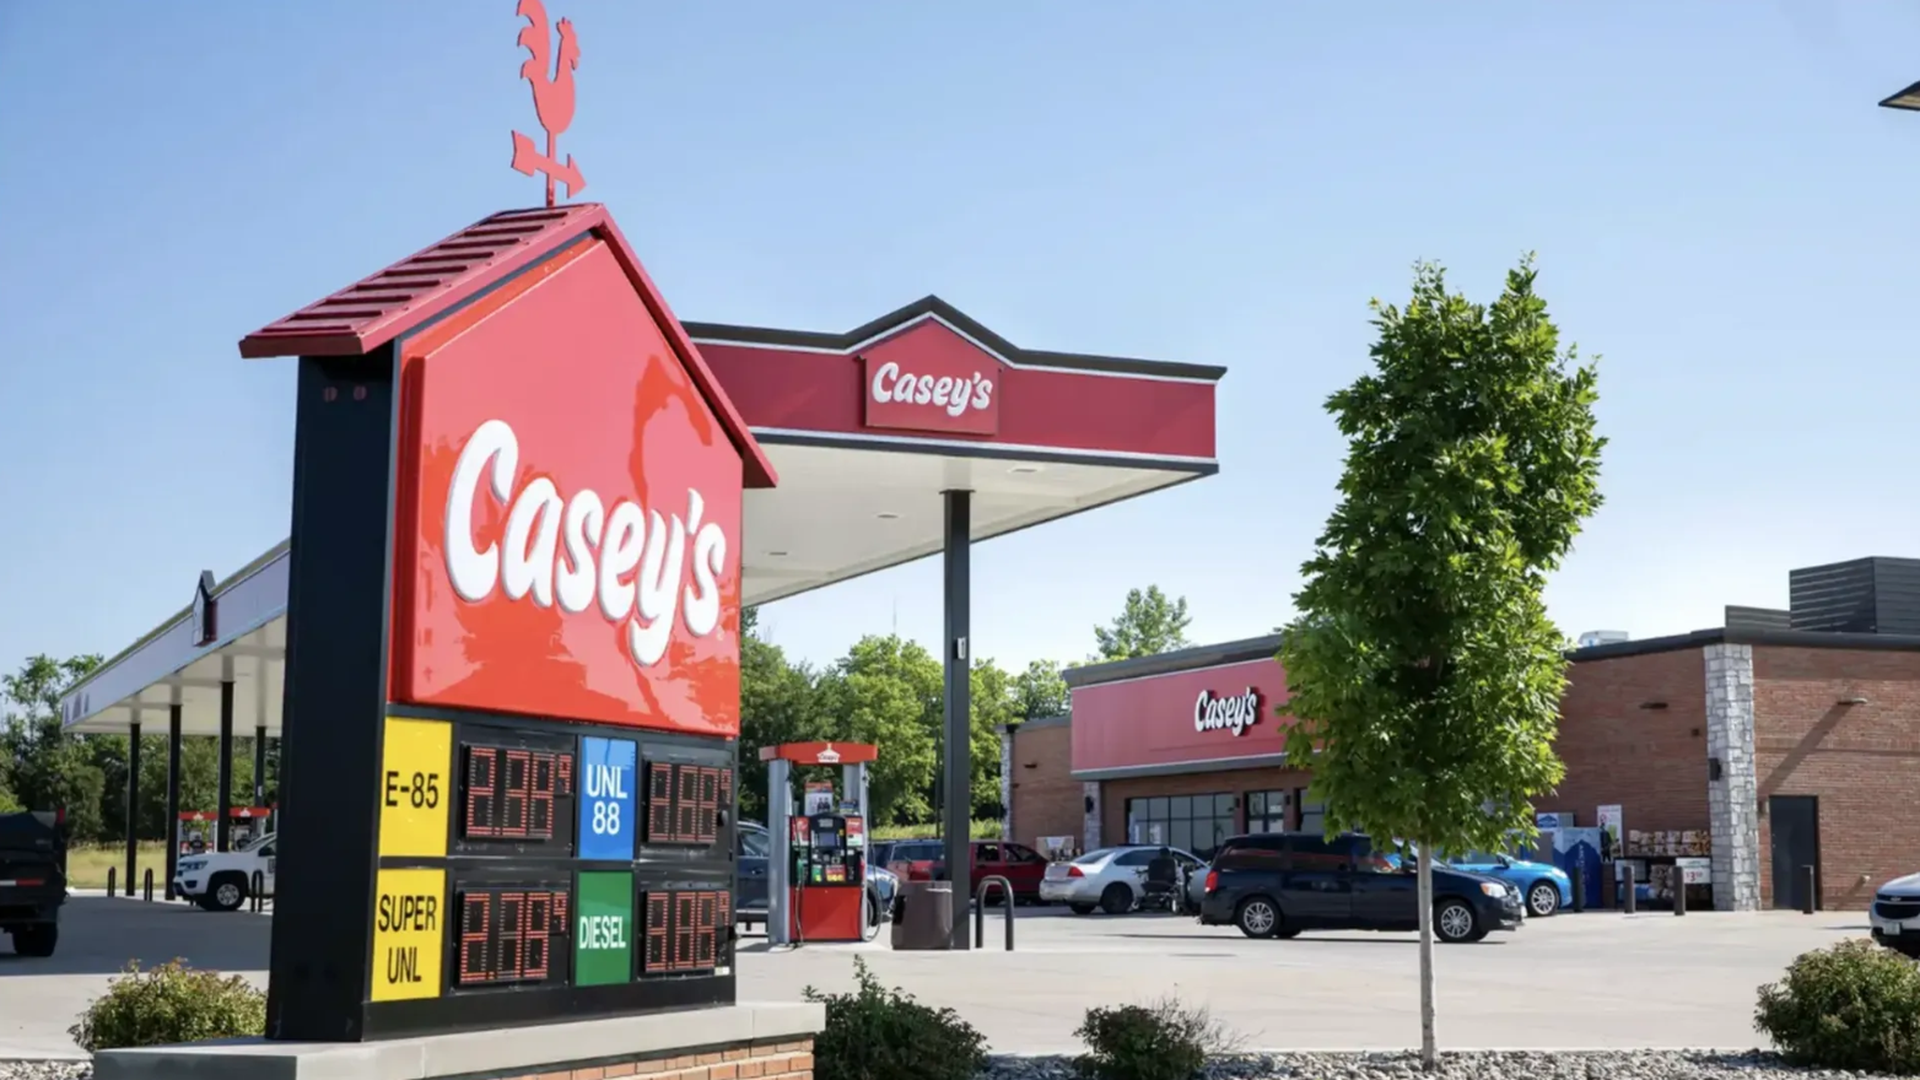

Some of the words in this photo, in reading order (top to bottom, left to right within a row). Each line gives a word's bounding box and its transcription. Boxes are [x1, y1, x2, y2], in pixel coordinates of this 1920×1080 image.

[872, 362, 993, 416] Casey's
[444, 419, 727, 667] Casey's
[1195, 686, 1258, 736] Casey's
[385, 771, 439, 809] E-85
[587, 764, 628, 799] UNL
[592, 801, 621, 835] 88
[378, 894, 437, 932] SUPER
[579, 916, 627, 949] DIESEL
[387, 947, 422, 984] UNL
